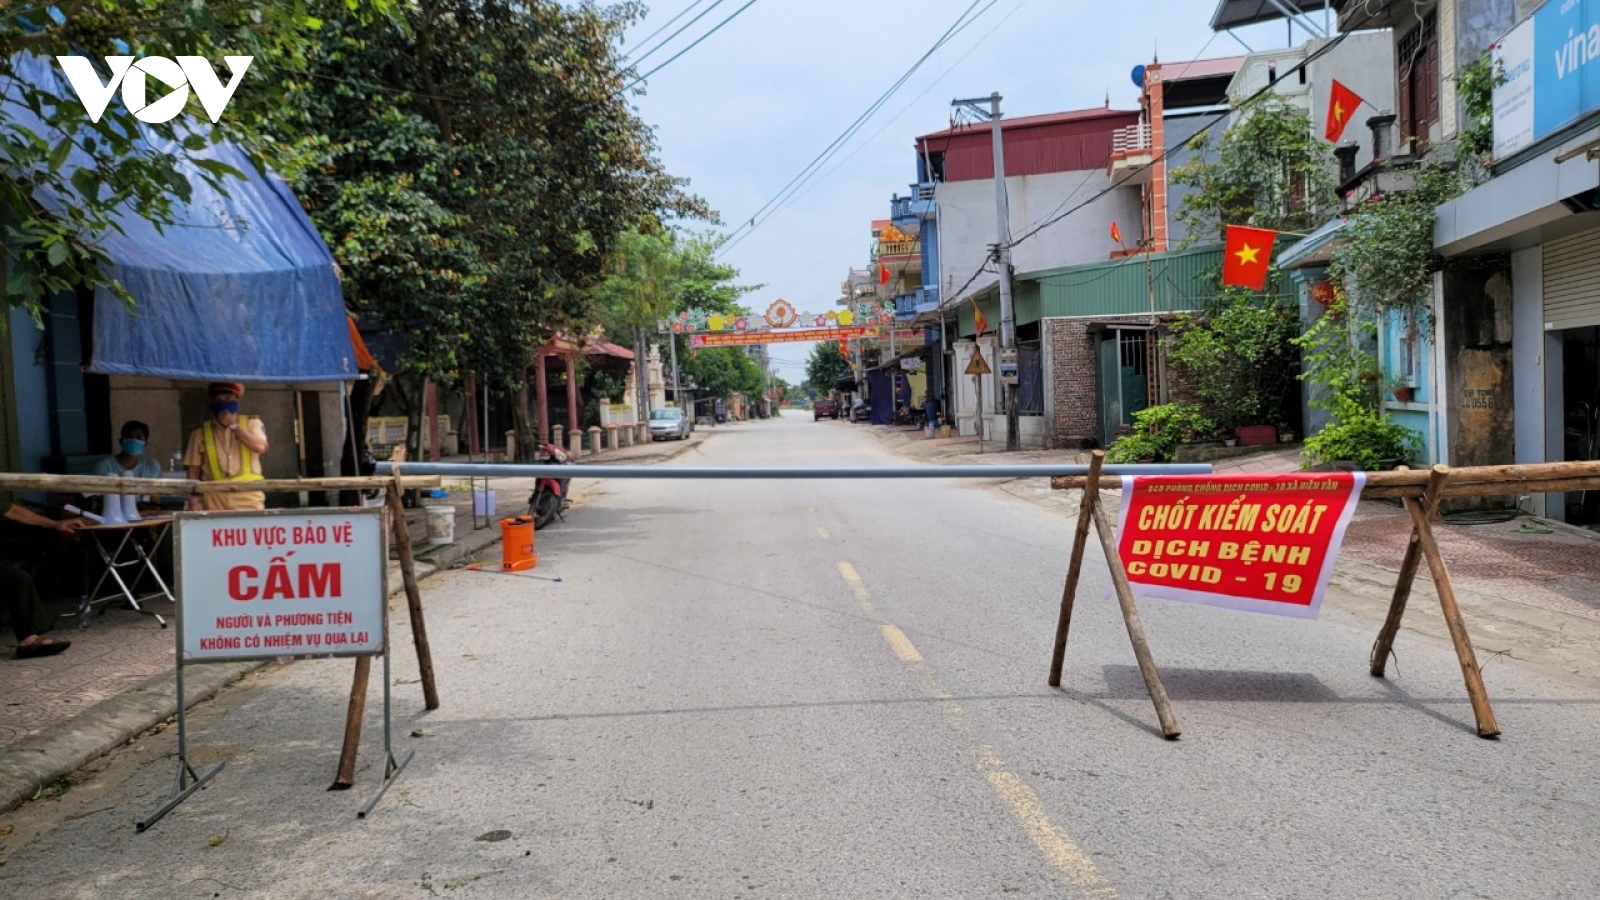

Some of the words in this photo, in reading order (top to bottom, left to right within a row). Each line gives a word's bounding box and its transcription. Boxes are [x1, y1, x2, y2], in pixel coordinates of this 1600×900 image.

[1244, 483, 1269, 491] COVID
[1138, 496, 1198, 531] CHỐT
[1198, 495, 1261, 532] KIỂM
[1260, 499, 1328, 534] SOÁT
[212, 528, 247, 547] KHU
[252, 526, 286, 550] VỰC
[293, 520, 327, 545] BẢO
[332, 521, 353, 547] VỆ
[1131, 540, 1210, 559] DỊCH
[1218, 540, 1311, 565] BỆNH
[227, 550, 342, 602] CẤM
[1127, 561, 1222, 584] COVID
[1263, 572, 1302, 593] 19
[216, 612, 253, 629] NGƯỜI
[275, 612, 323, 627] PHƯƠNG
[326, 610, 353, 627] TIỆN
[200, 634, 241, 650] KHÔNG
[244, 633, 260, 648] CÓ
[264, 632, 302, 649] NHIỆM
[306, 634, 321, 648] VỤ
[325, 633, 347, 645] QUA
[350, 631, 368, 646] LẠI
